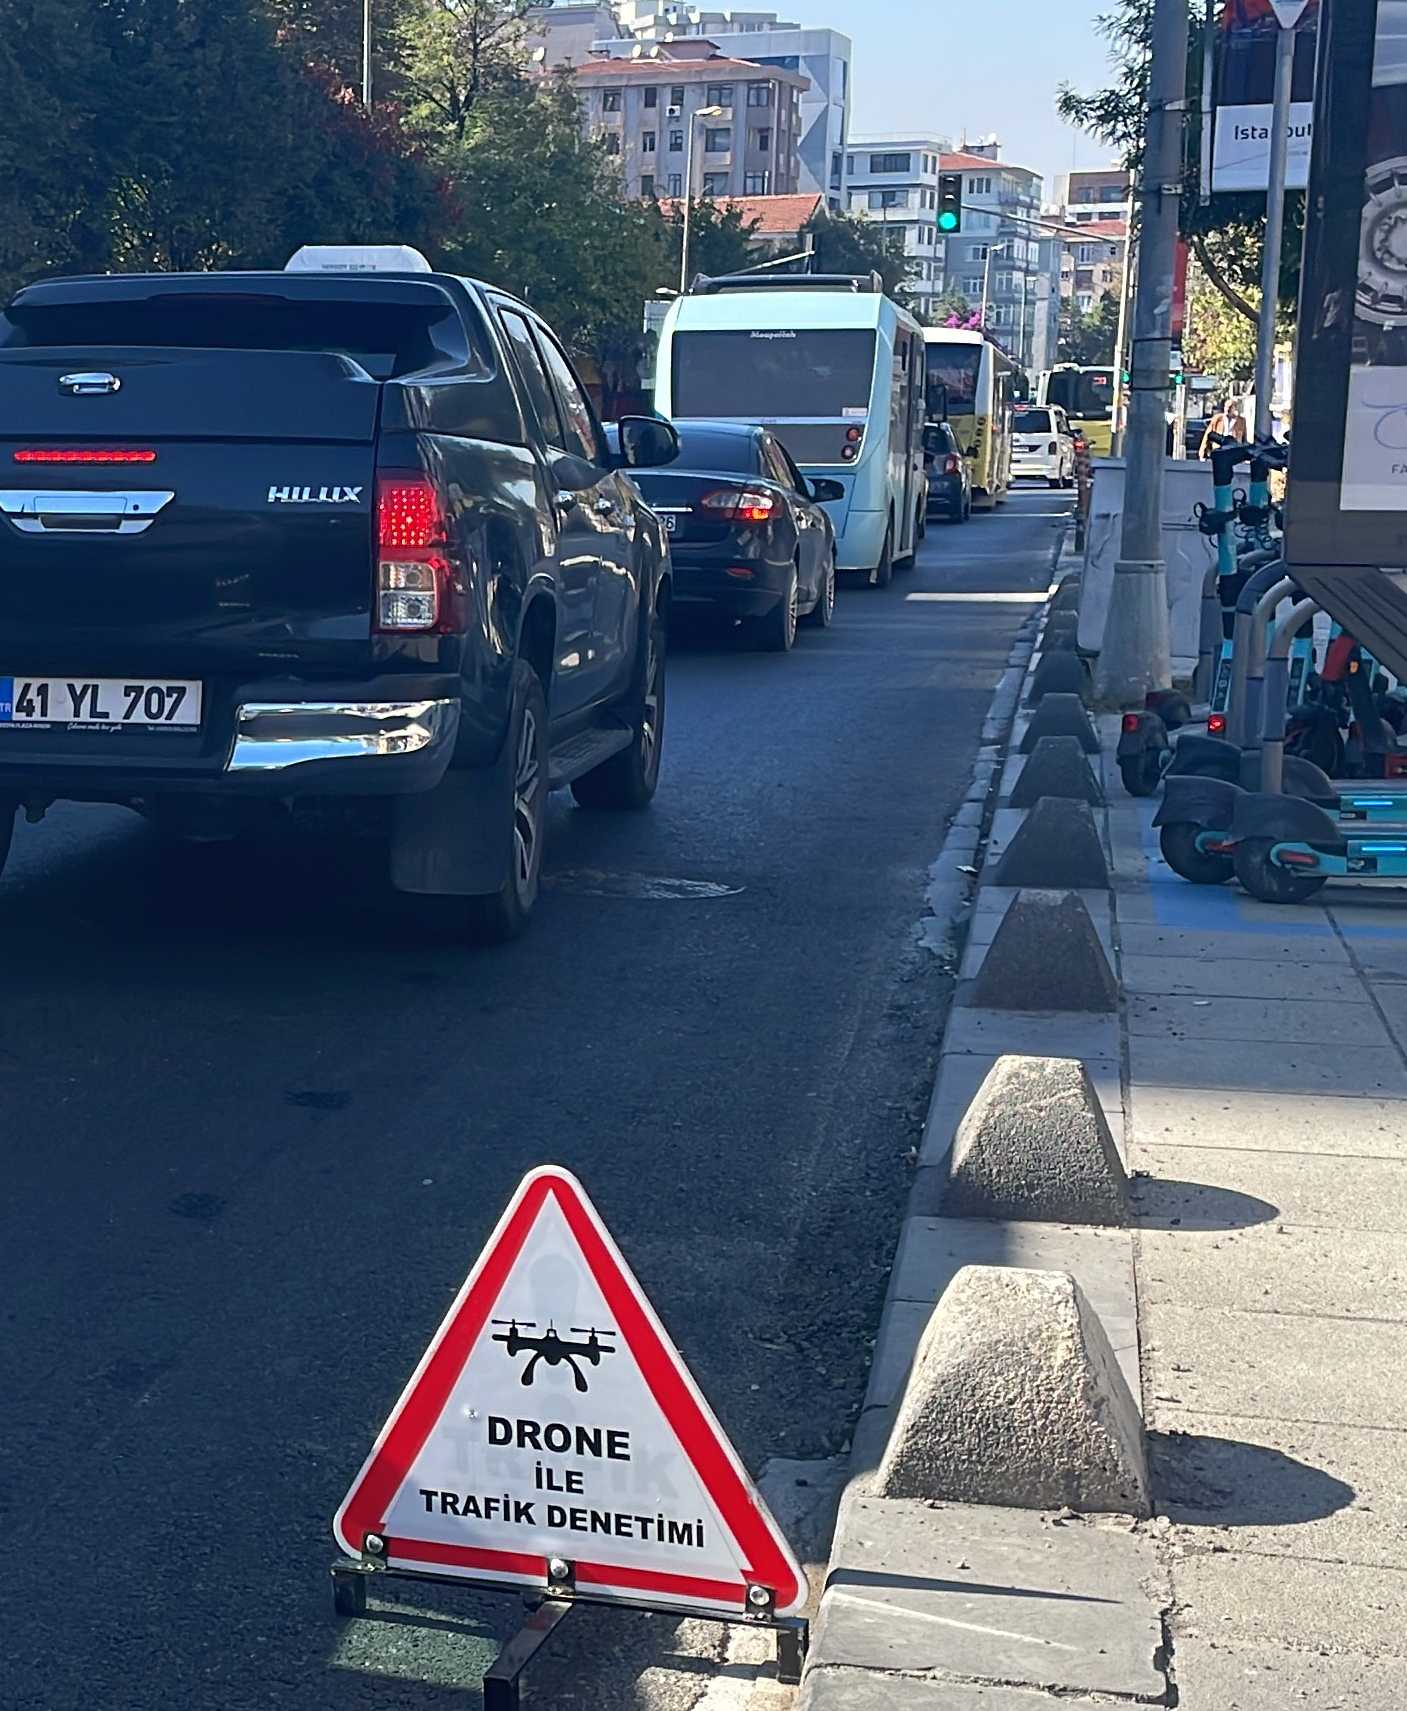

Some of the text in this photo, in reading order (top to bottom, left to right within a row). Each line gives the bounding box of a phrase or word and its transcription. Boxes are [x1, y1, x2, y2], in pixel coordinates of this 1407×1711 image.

[1234, 123, 1312, 140] Istaul
[268, 486, 363, 503] HILUX
[0, 683, 187, 721] TR 41 YL 707
[488, 1415, 631, 1461] DRONE
[535, 1461, 584, 1494] İLE
[419, 1489, 704, 1547] TRAFİK DENETİMİ
